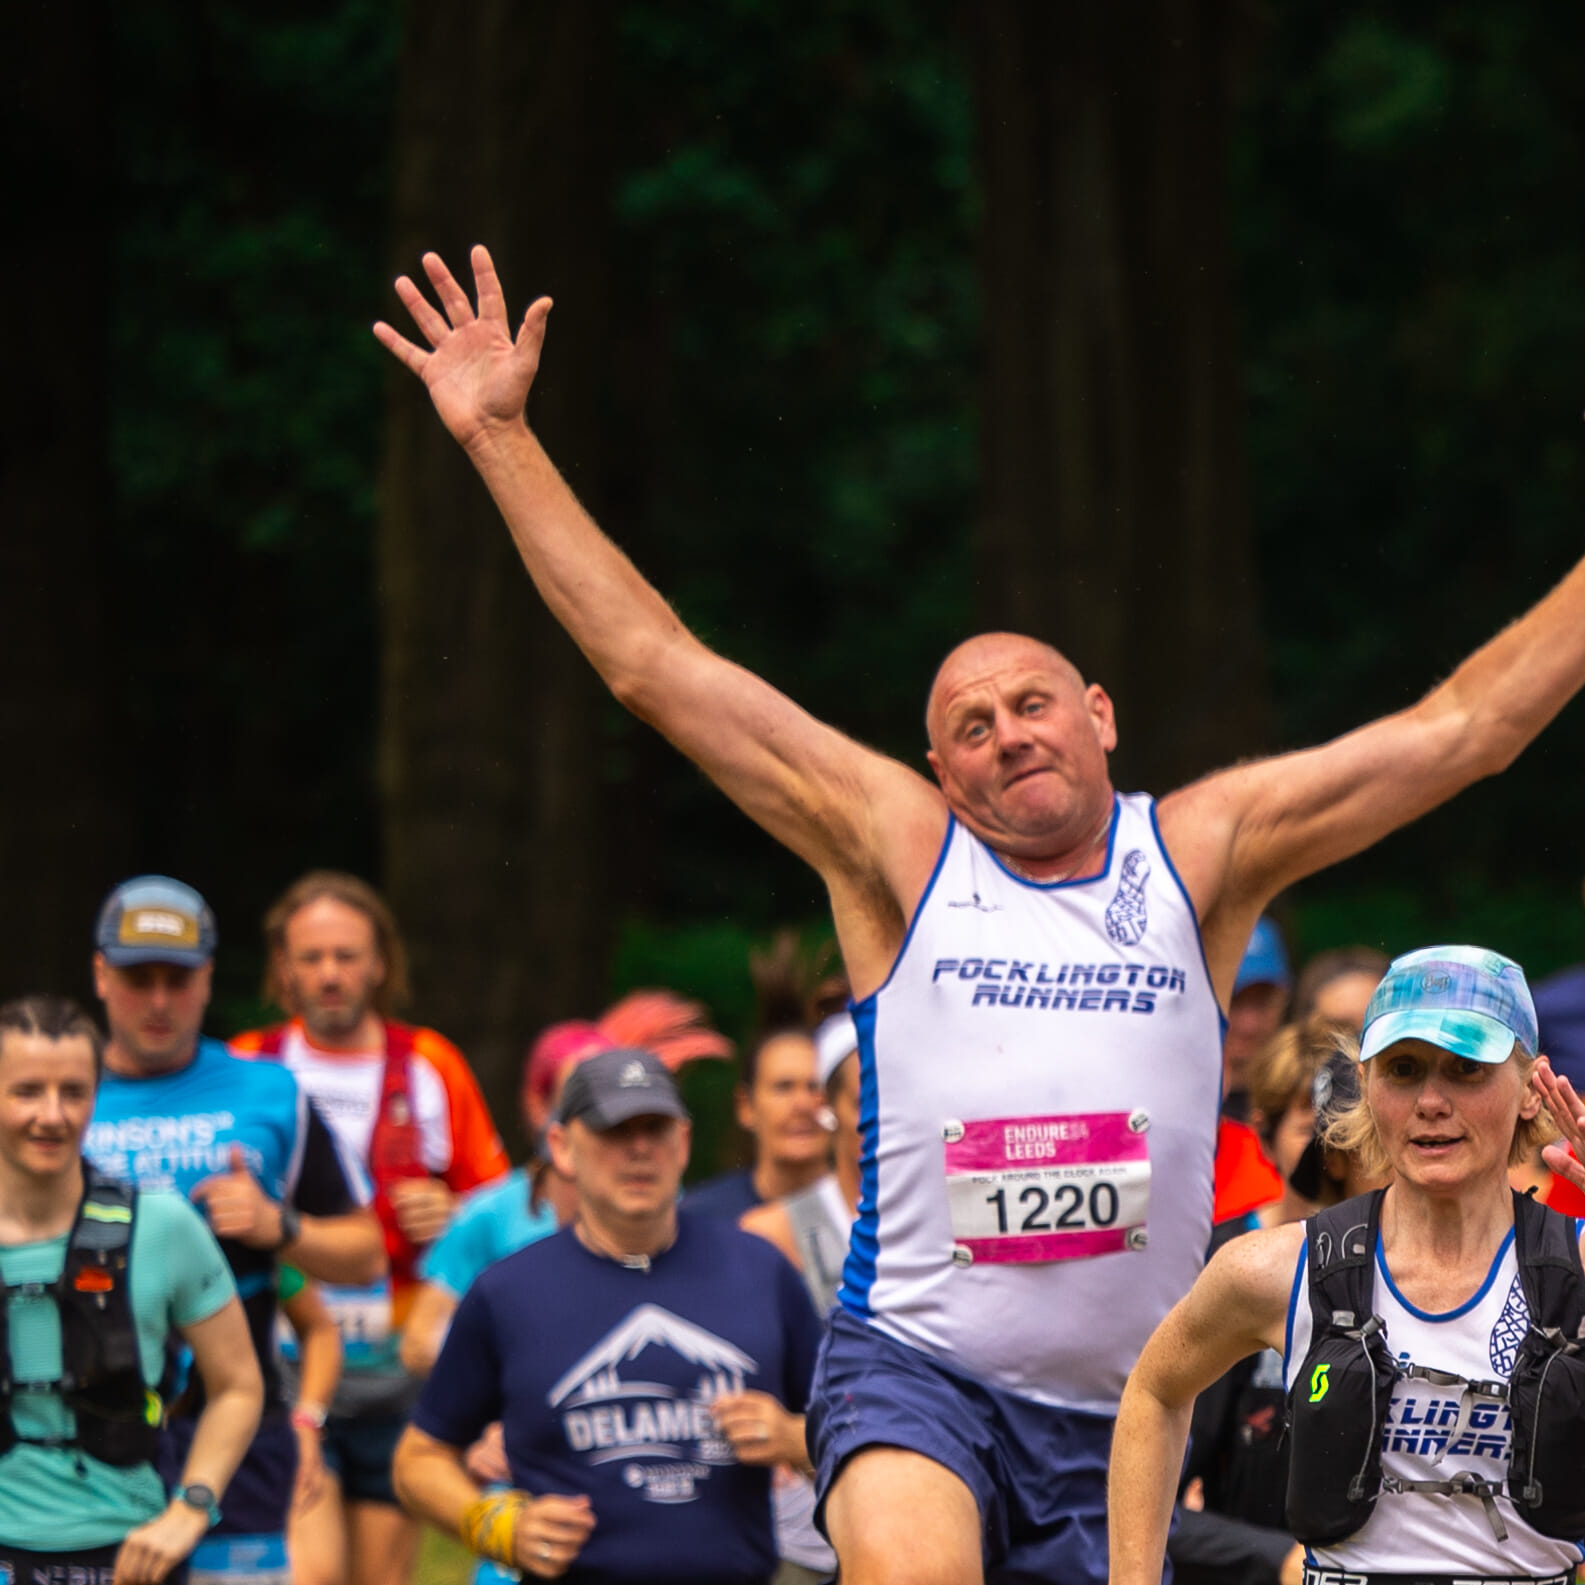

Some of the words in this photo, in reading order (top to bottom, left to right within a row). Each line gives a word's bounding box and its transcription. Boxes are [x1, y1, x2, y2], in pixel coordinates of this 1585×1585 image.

[932, 958, 1186, 994] POCKLINGTON
[972, 984, 1157, 1015] RUNNERS
[1005, 1142, 1056, 1161] LEEDS
[1044, 1170, 1060, 1179] THE
[986, 1182, 1119, 1233] 1220
[565, 1402, 721, 1451] DELAME
